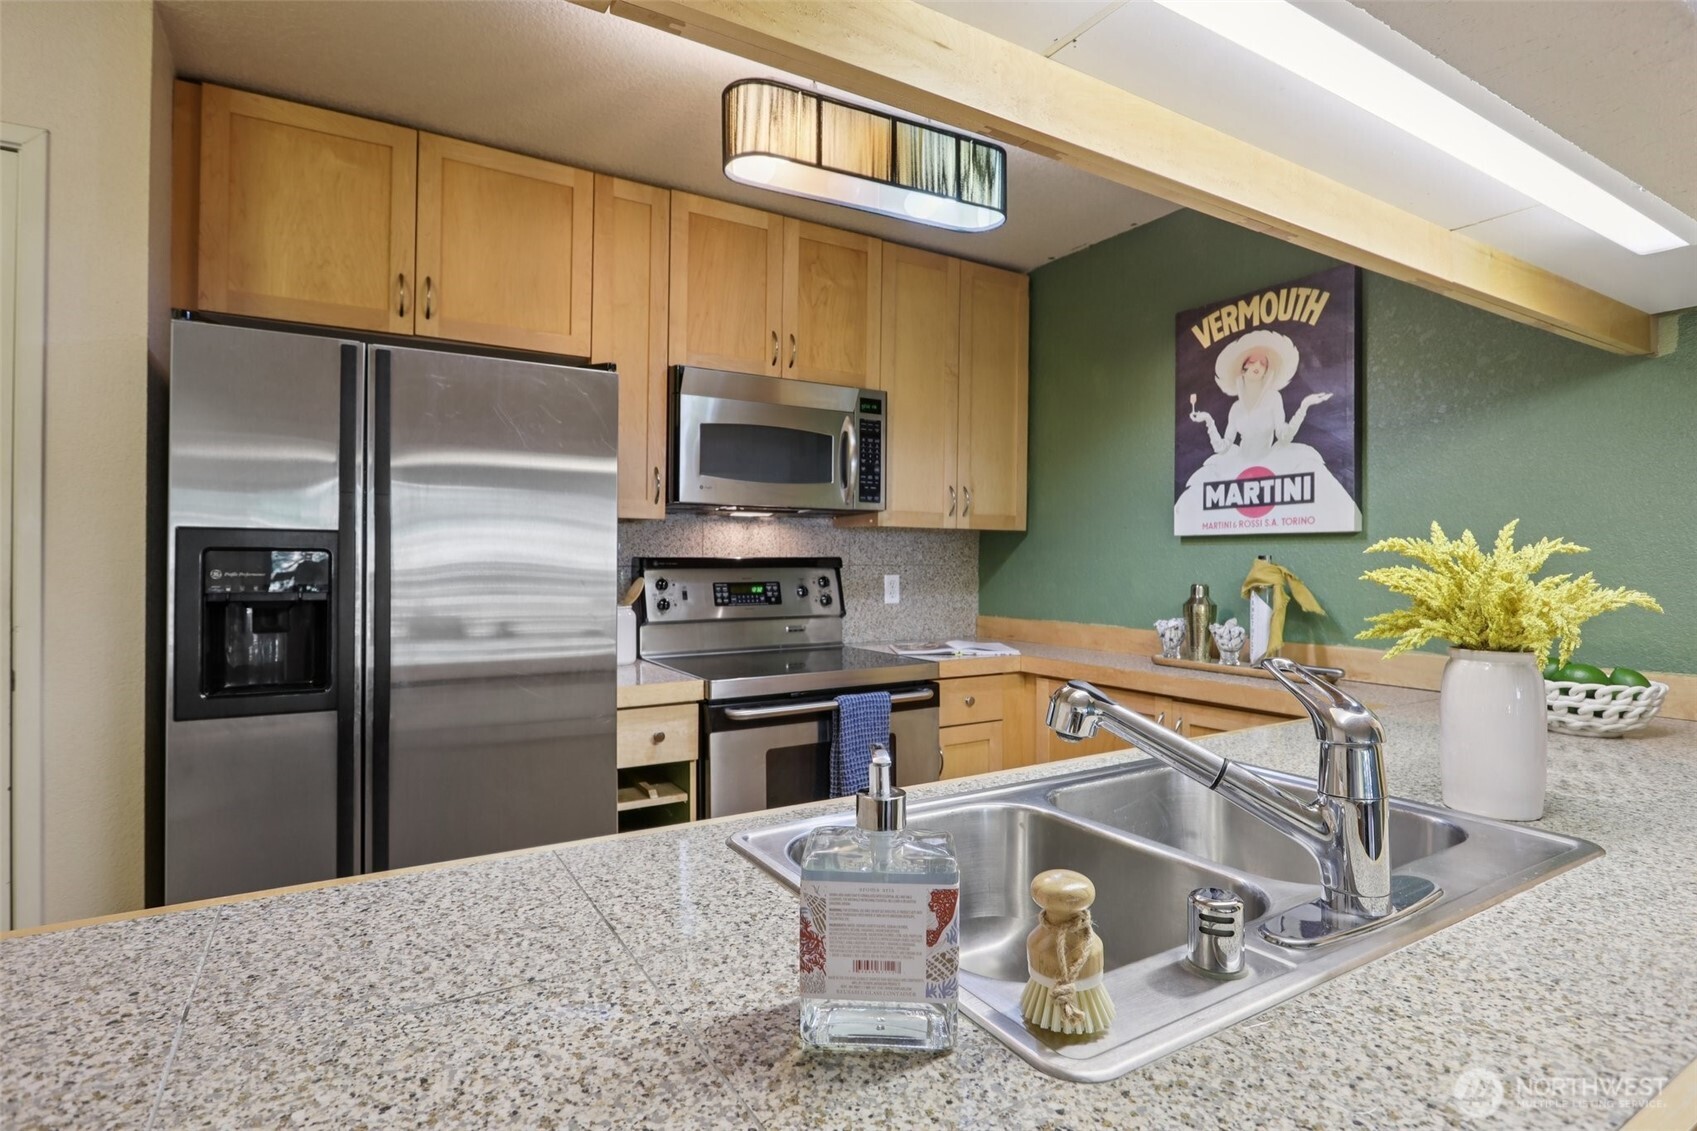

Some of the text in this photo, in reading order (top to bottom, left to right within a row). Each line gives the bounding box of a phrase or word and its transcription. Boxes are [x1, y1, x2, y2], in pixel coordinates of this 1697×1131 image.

[1191, 287, 1330, 349] VERMOUTH
[1205, 475, 1312, 508] MARTINI
[1202, 519, 1232, 530] MARTINI
[1239, 519, 1262, 528] ROSSI
[1282, 516, 1316, 526] TORINO
